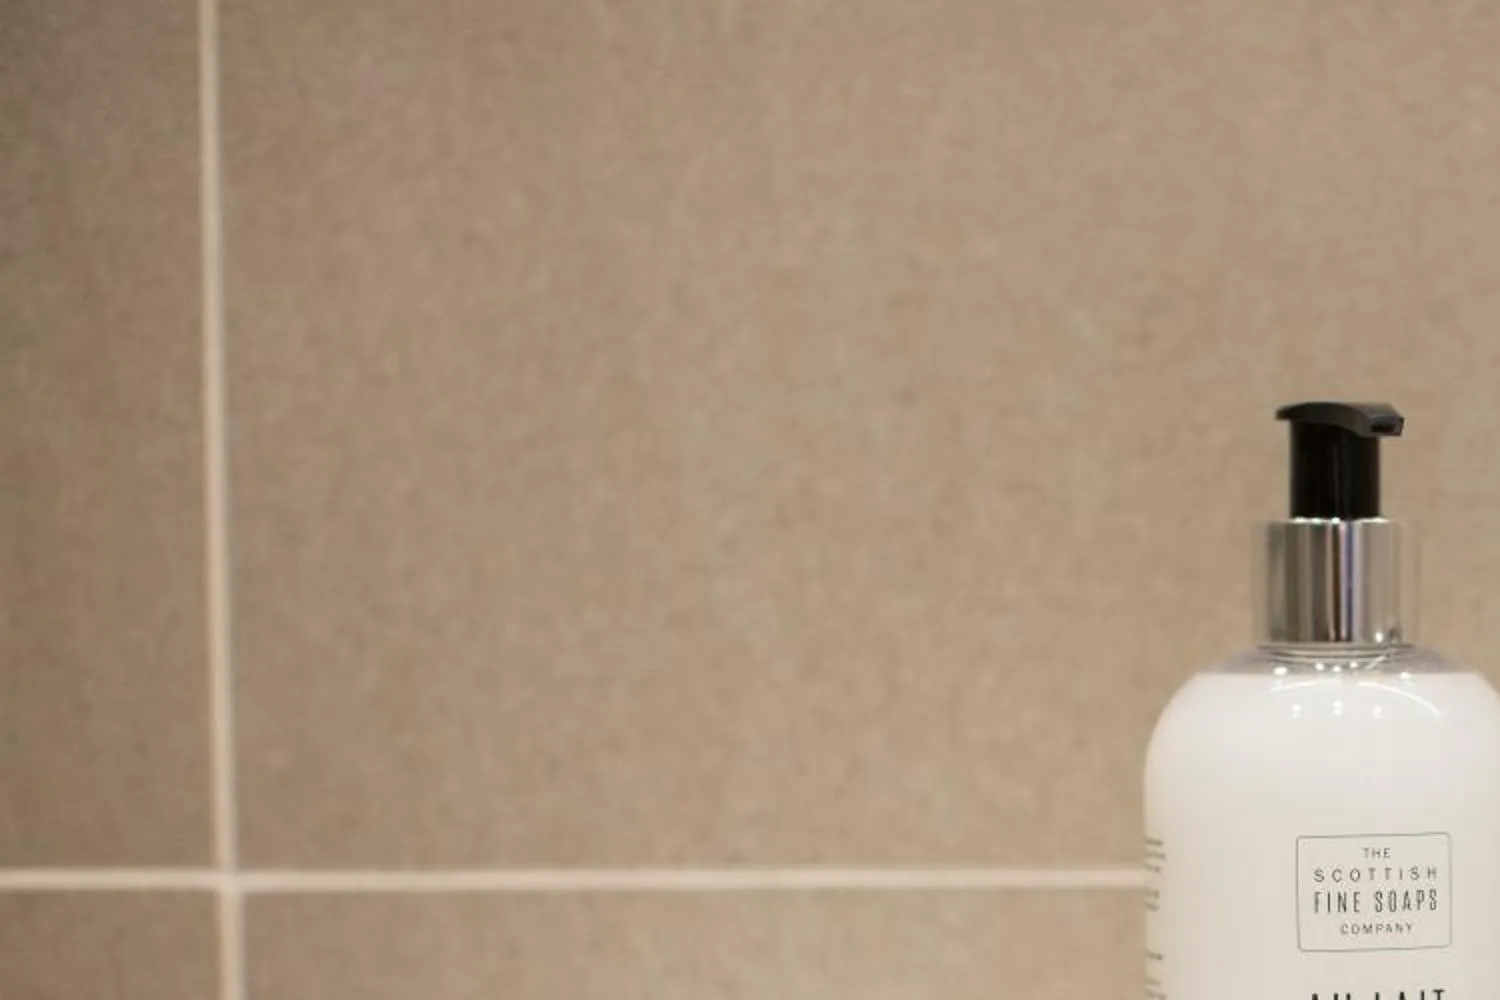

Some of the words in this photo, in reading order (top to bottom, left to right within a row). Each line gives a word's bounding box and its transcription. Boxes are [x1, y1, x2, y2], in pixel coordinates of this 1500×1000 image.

[1362, 848, 1391, 859] THE
[1313, 866, 1438, 882] SCOTTISH
[1313, 891, 1361, 913] FINE
[1375, 889, 1438, 912] SOAPS
[1340, 922, 1414, 934] COMPANY
